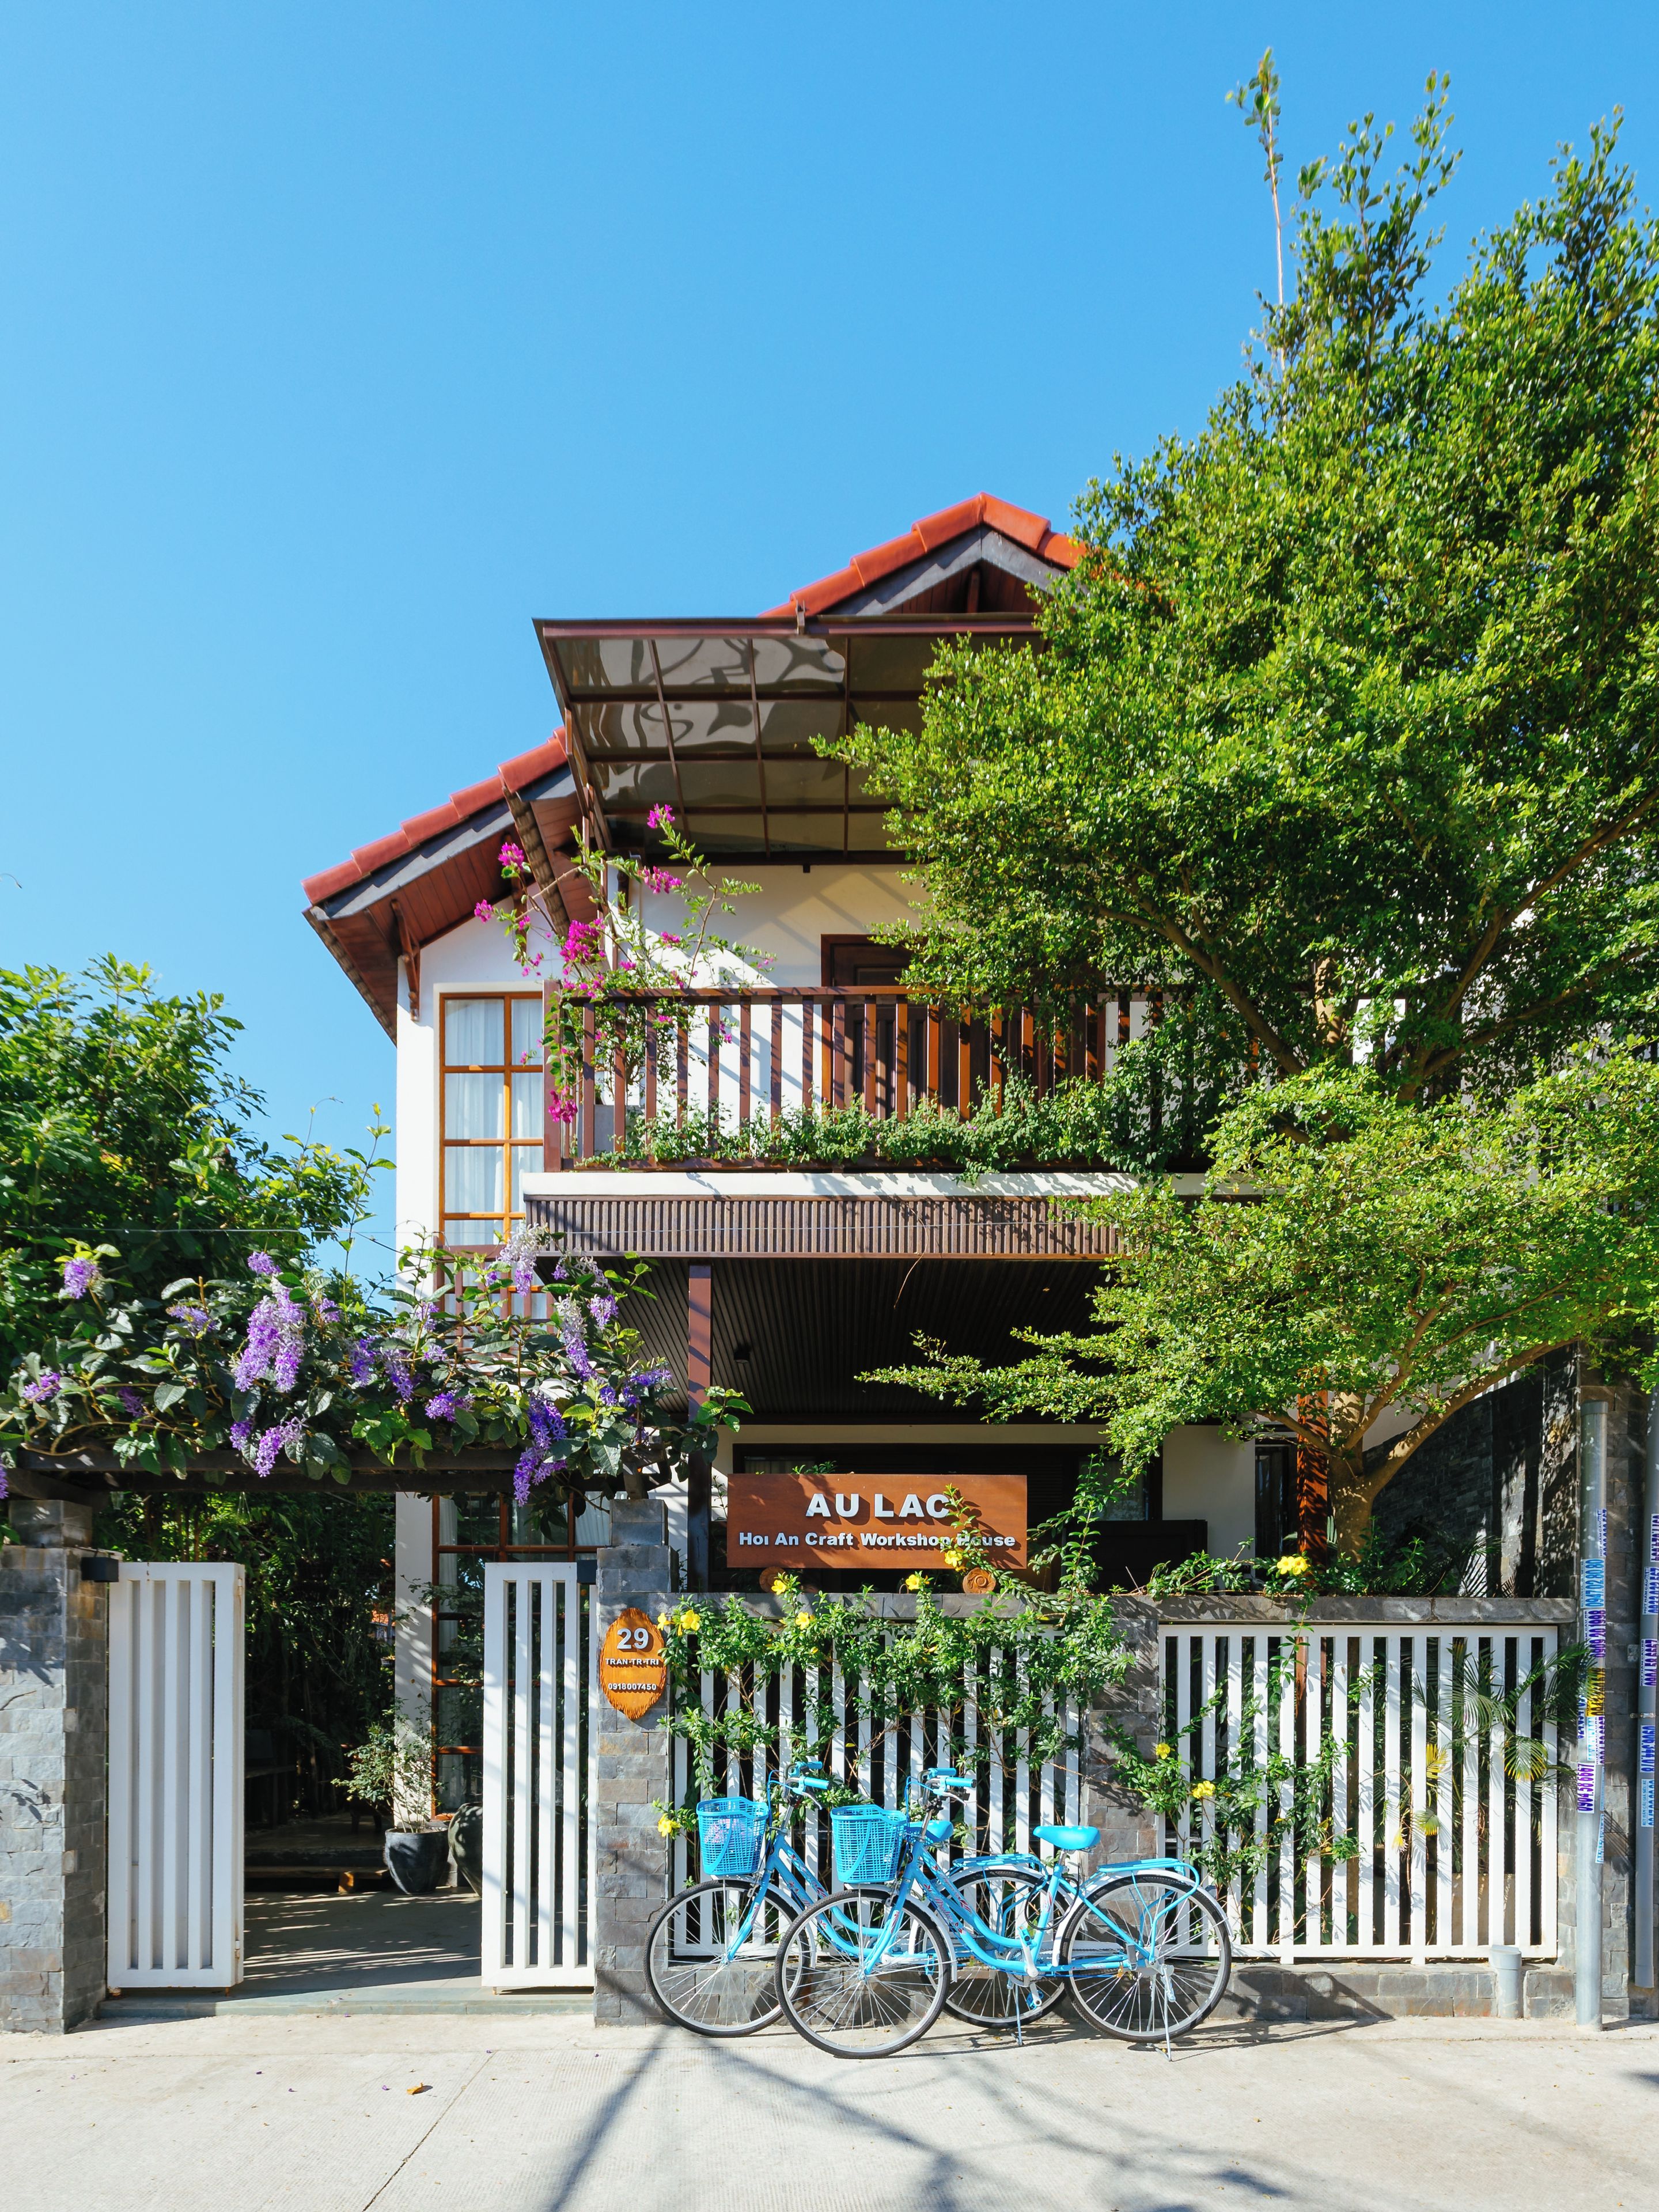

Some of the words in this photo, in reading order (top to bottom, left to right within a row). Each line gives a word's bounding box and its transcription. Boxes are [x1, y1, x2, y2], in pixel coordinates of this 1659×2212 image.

[806, 1493, 859, 1518] AU
[874, 1493, 950, 1518] LAC
[775, 1532, 799, 1546] An
[805, 1532, 853, 1546] Craft
[861, 1532, 950, 1549] Workshop
[617, 1627, 649, 1649] 29
